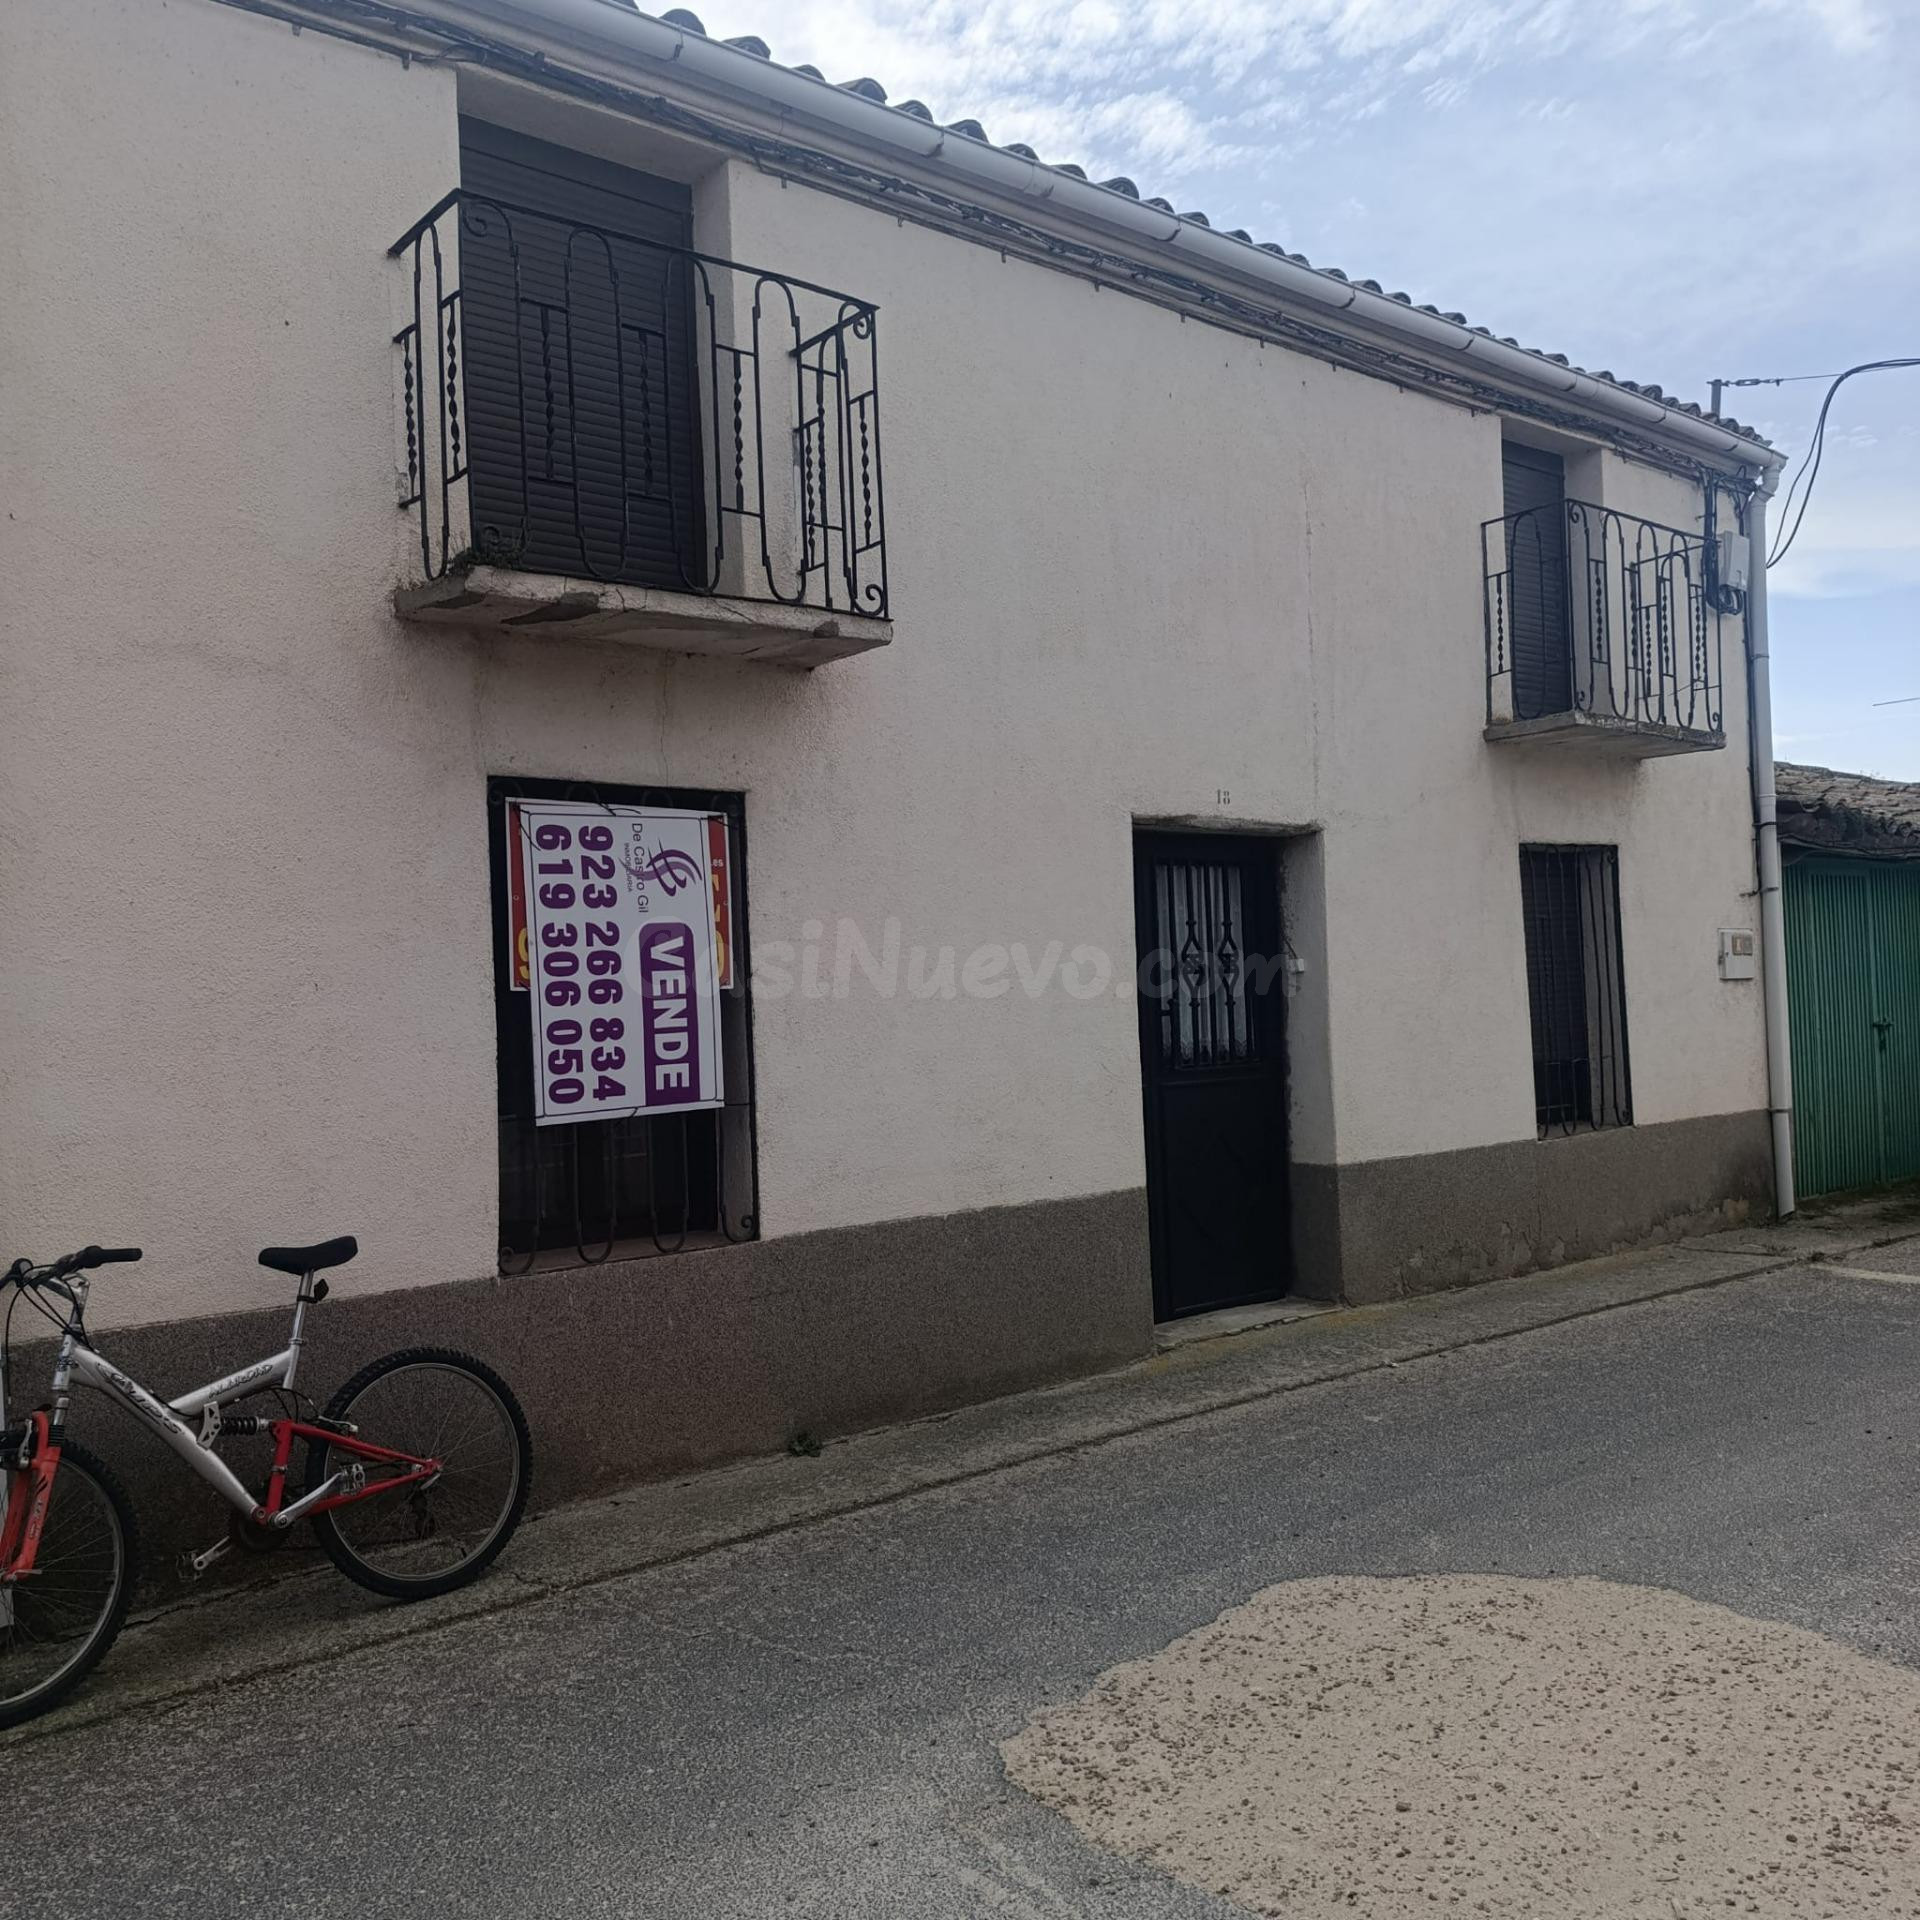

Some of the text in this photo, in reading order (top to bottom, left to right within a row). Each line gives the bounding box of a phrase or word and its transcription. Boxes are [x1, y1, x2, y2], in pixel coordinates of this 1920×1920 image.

[1217, 789, 1230, 805] 18
[624, 842, 633, 893] INMOBIARIA
[631, 823, 649, 913] De Casro Gil
[535, 824, 585, 1104] 619 306 050
[578, 825, 626, 1101] 923 266 834
[649, 935, 690, 1091] VENDE
